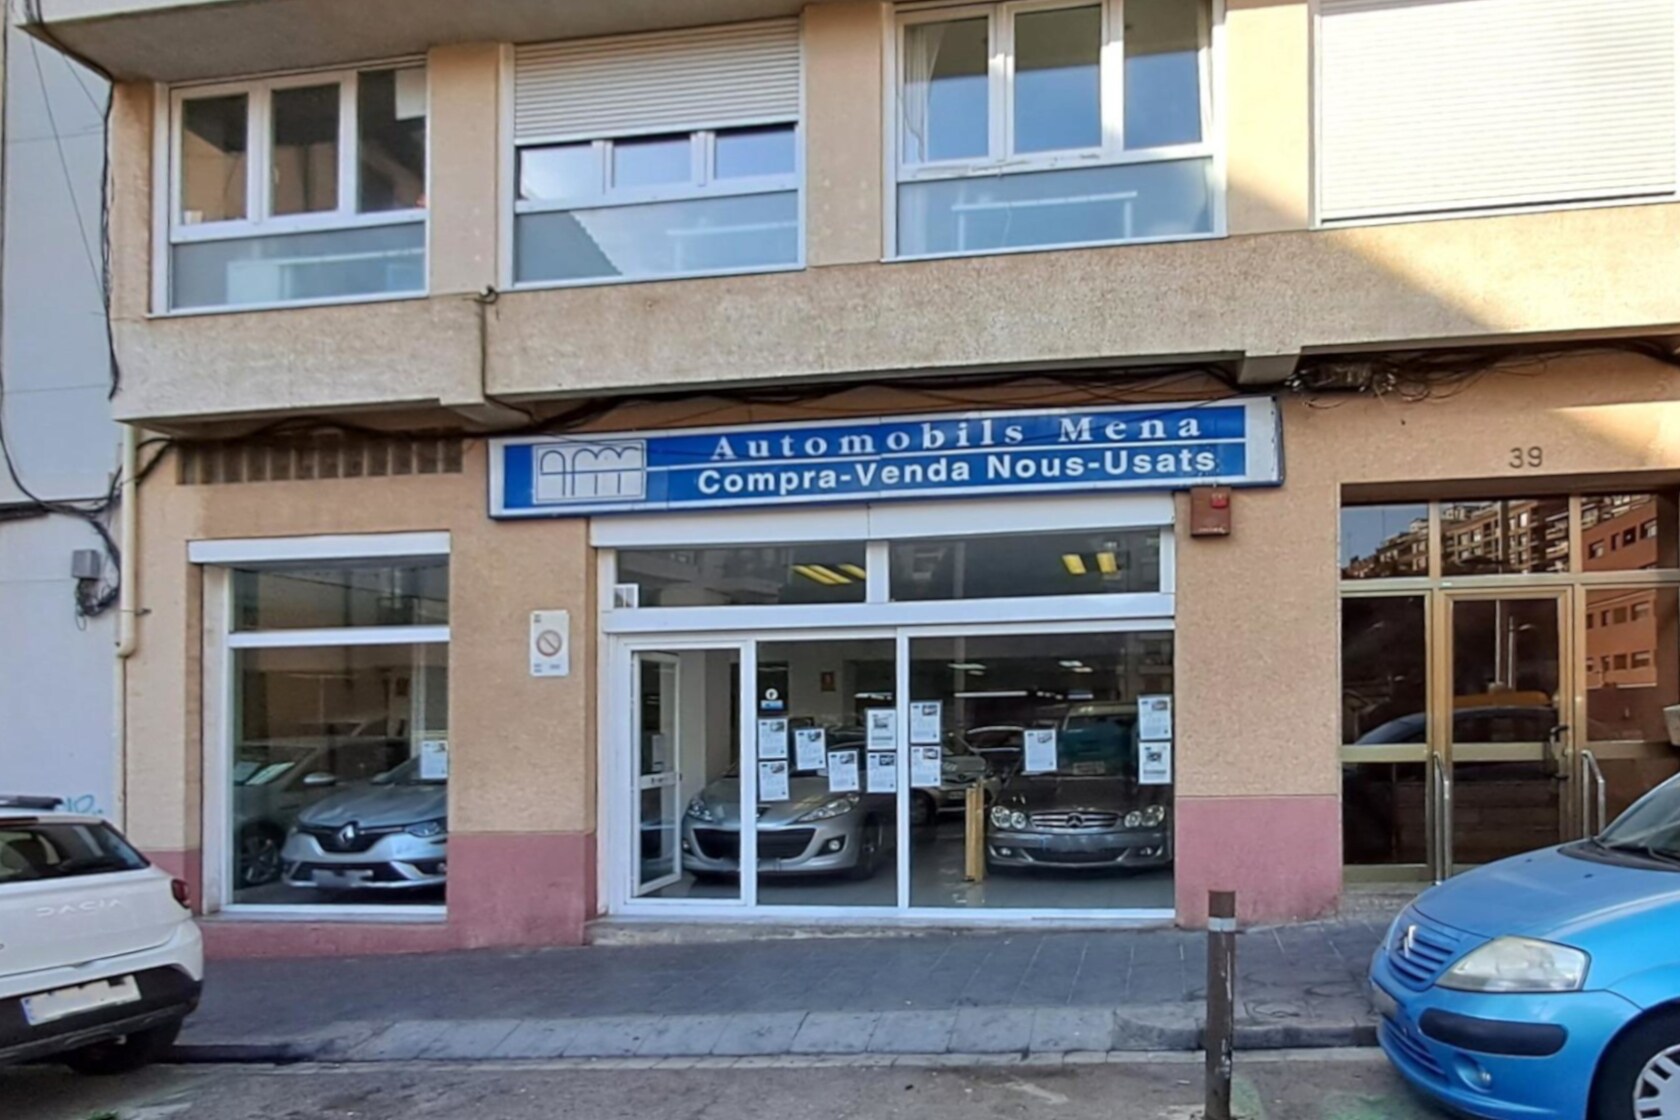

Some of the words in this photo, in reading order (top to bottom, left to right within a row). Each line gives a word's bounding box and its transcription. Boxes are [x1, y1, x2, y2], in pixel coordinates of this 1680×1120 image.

[709, 419, 1024, 461] Automobils
[1057, 416, 1201, 443] Mena
[697, 456, 971, 496] Compra-Venda
[986, 448, 1216, 480] Nous-Usats
[1509, 446, 1543, 469] 39
[35, 897, 122, 918] DACIA
